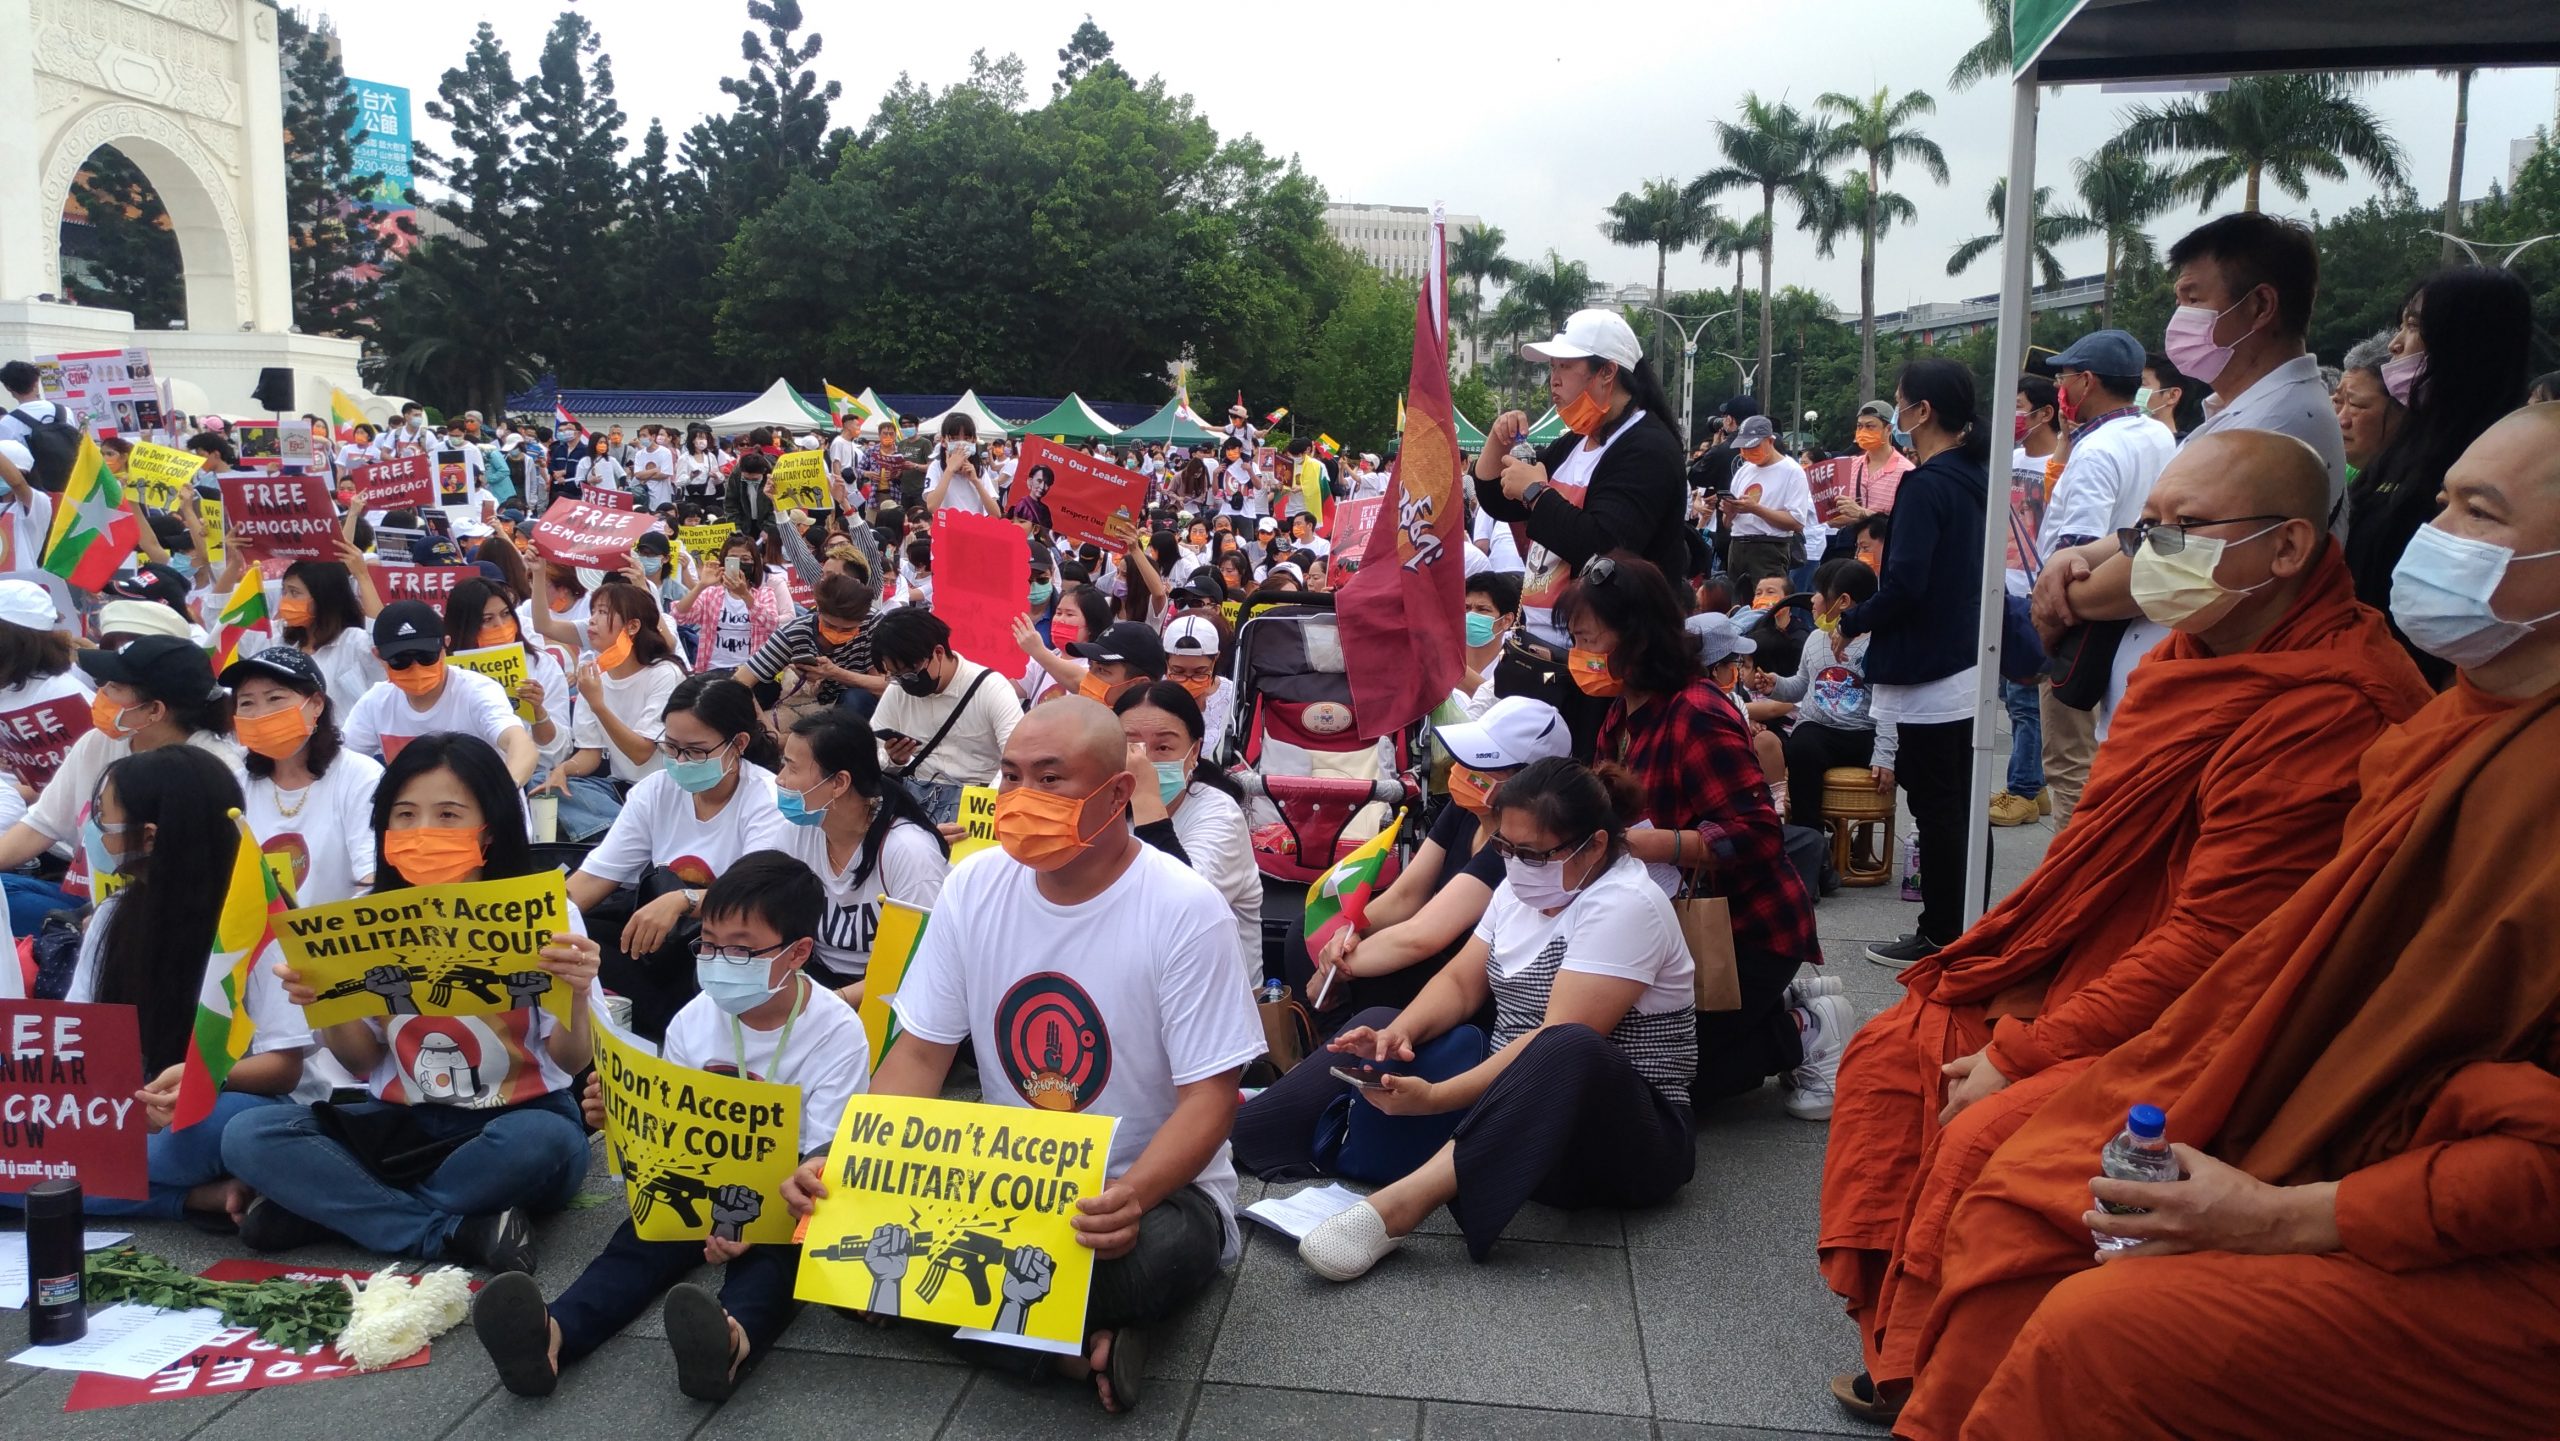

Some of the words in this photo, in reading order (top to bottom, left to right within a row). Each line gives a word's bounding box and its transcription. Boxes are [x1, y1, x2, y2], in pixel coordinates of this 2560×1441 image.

[363, 88, 397, 114] 台大
[364, 111, 398, 136] 公館
[136, 447, 149, 457] We
[149, 449, 170, 462] Don't
[171, 457, 199, 469] Accept
[782, 458, 799, 469] Don't
[800, 456, 820, 469] Accept
[1041, 449, 1064, 464] Free
[1069, 459, 1089, 473] Our
[1092, 467, 1128, 487] Leader
[132, 459, 167, 474] MILITARY
[167, 466, 189, 479] COUP
[369, 461, 415, 481] FREE
[773, 470, 801, 482] MILITARY
[802, 468, 820, 480] COUP
[1810, 463, 1835, 484] FREE
[243, 483, 306, 508] FREE
[361, 478, 429, 501] DEMOCRACY
[582, 488, 618, 508] FREE
[205, 506, 220, 516] We
[568, 506, 634, 528] FREE
[1061, 506, 1089, 521] Respect
[1090, 516, 1104, 527] Our
[238, 518, 332, 535] DEMOCRACY
[539, 522, 633, 546] DEMOCRACY
[690, 529, 709, 537] Don't
[709, 527, 733, 537] Accept
[389, 572, 456, 593] FREE
[1223, 607, 1239, 618] We
[469, 656, 520, 674] Accept
[970, 796, 996, 817] We
[287, 915, 345, 937] We
[353, 897, 447, 927] Don't
[453, 891, 556, 929] Accept
[304, 925, 459, 959] MILITARY
[467, 929, 553, 955] COUP
[592, 1025, 608, 1071] We
[612, 1051, 671, 1108] Don't
[676, 1085, 785, 1133] Accept
[684, 1126, 776, 1163] COUP
[850, 1111, 895, 1147] We
[901, 1115, 985, 1157] Don't
[988, 1125, 1094, 1177] Accept
[842, 1154, 987, 1204] MILITARY
[990, 1173, 1080, 1215] COUP
